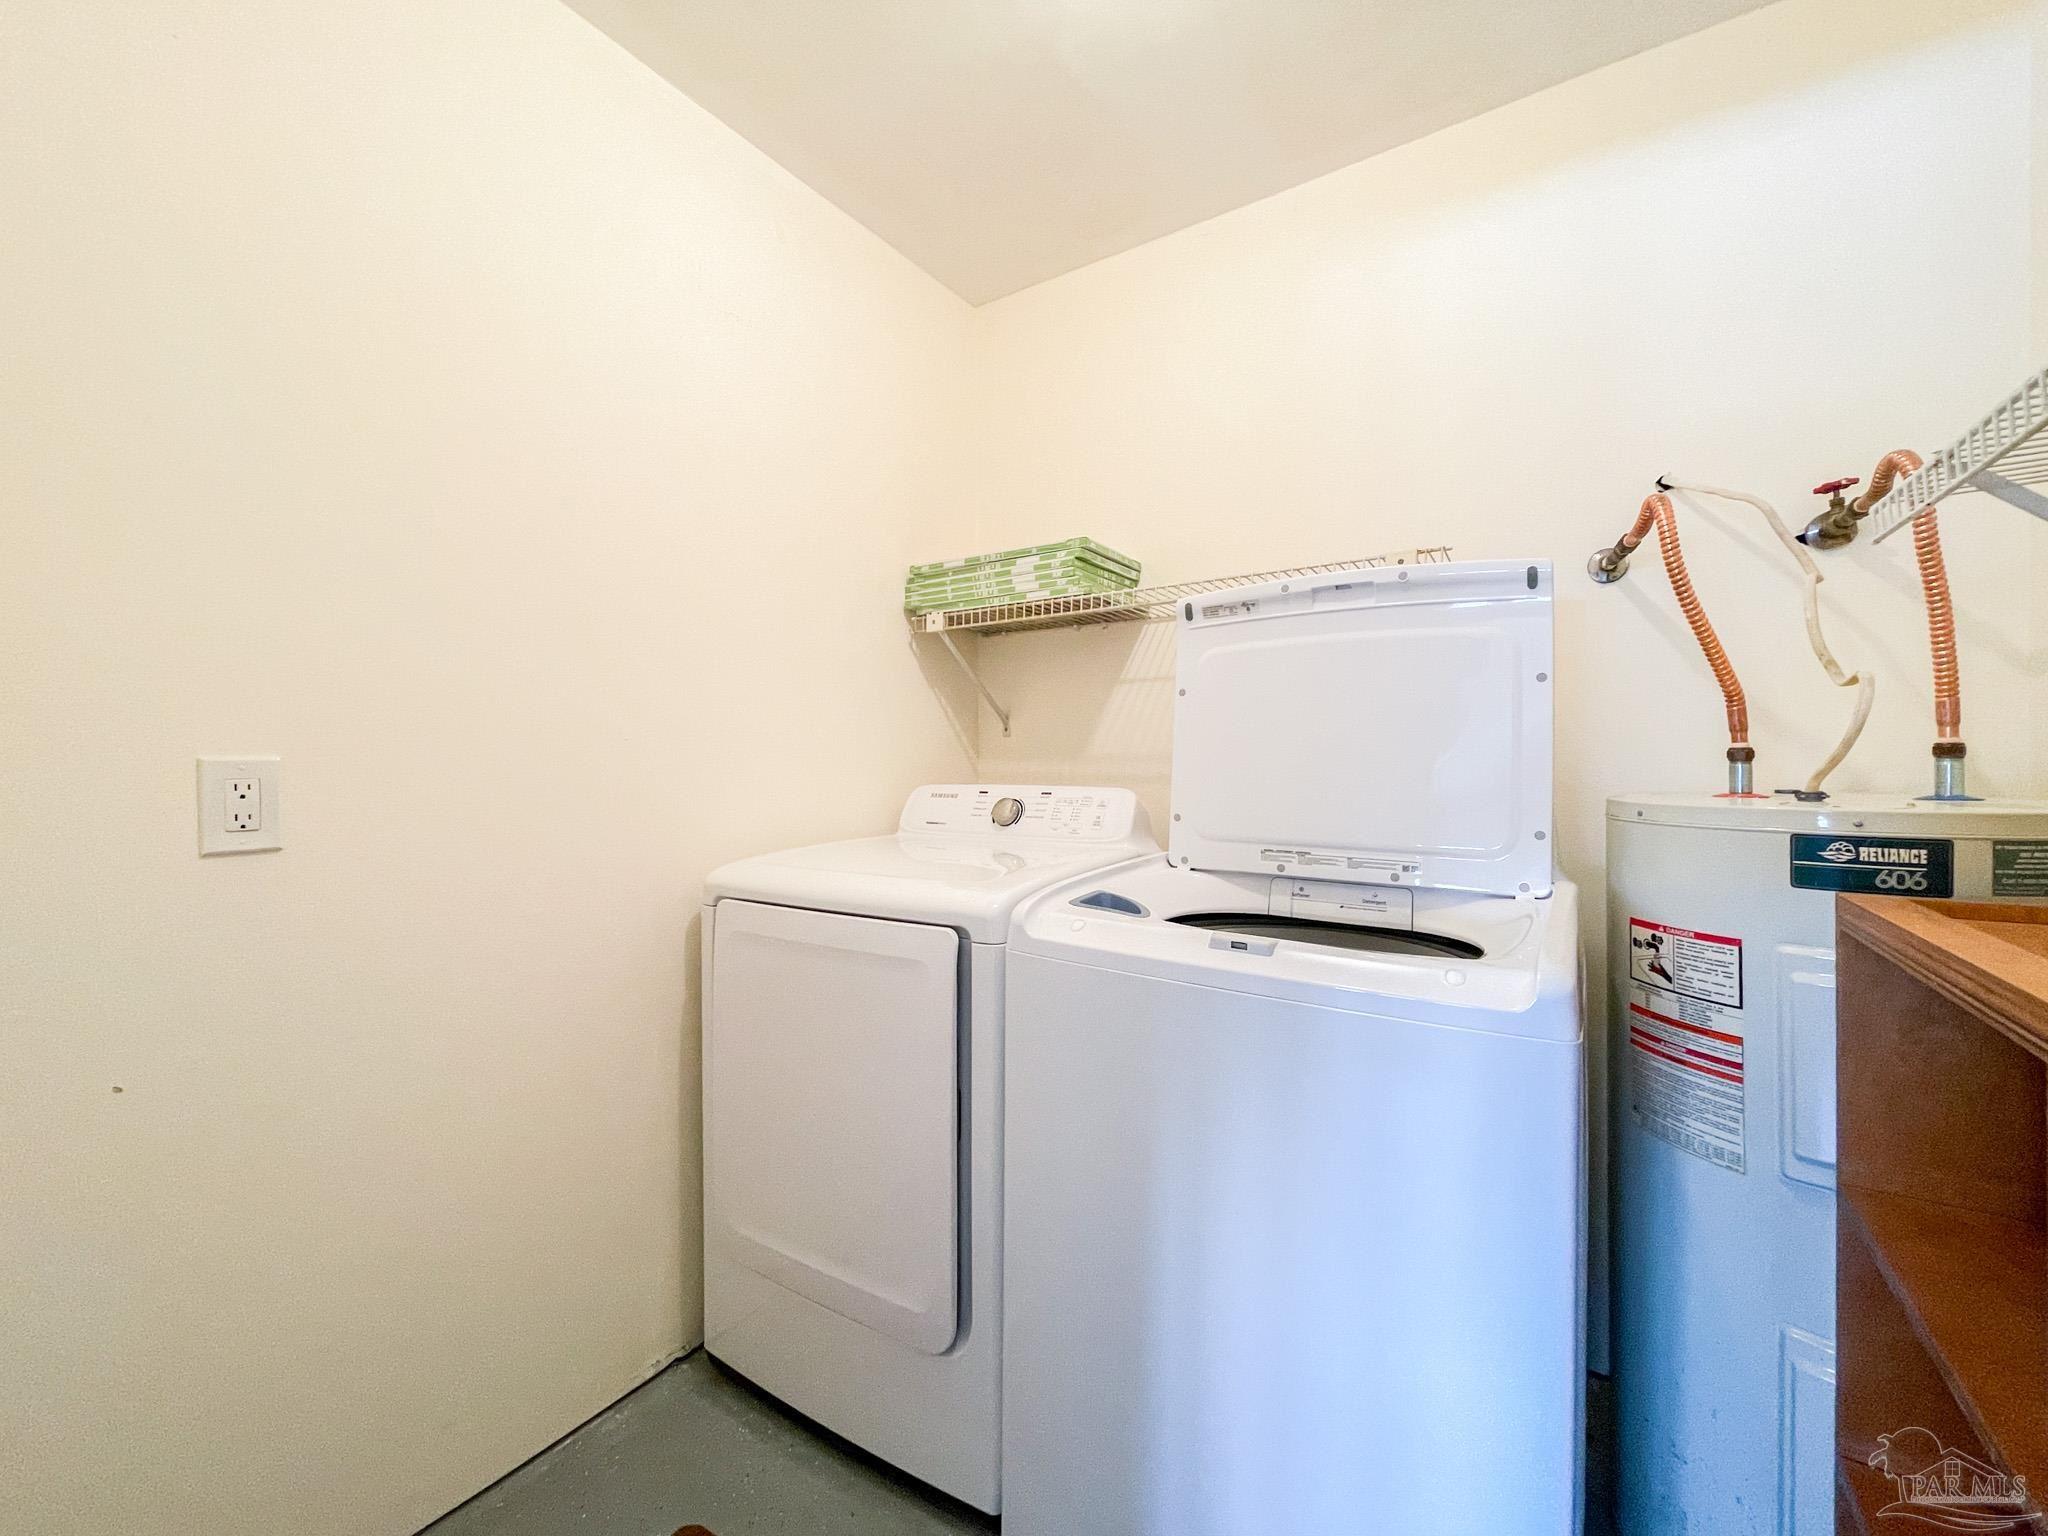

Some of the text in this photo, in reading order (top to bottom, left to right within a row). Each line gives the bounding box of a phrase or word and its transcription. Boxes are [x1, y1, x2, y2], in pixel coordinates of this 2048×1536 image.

[1858, 846, 1928, 864] RELIANCE
[1874, 869, 1928, 891] 606
[1665, 927, 1695, 939] DANGER
